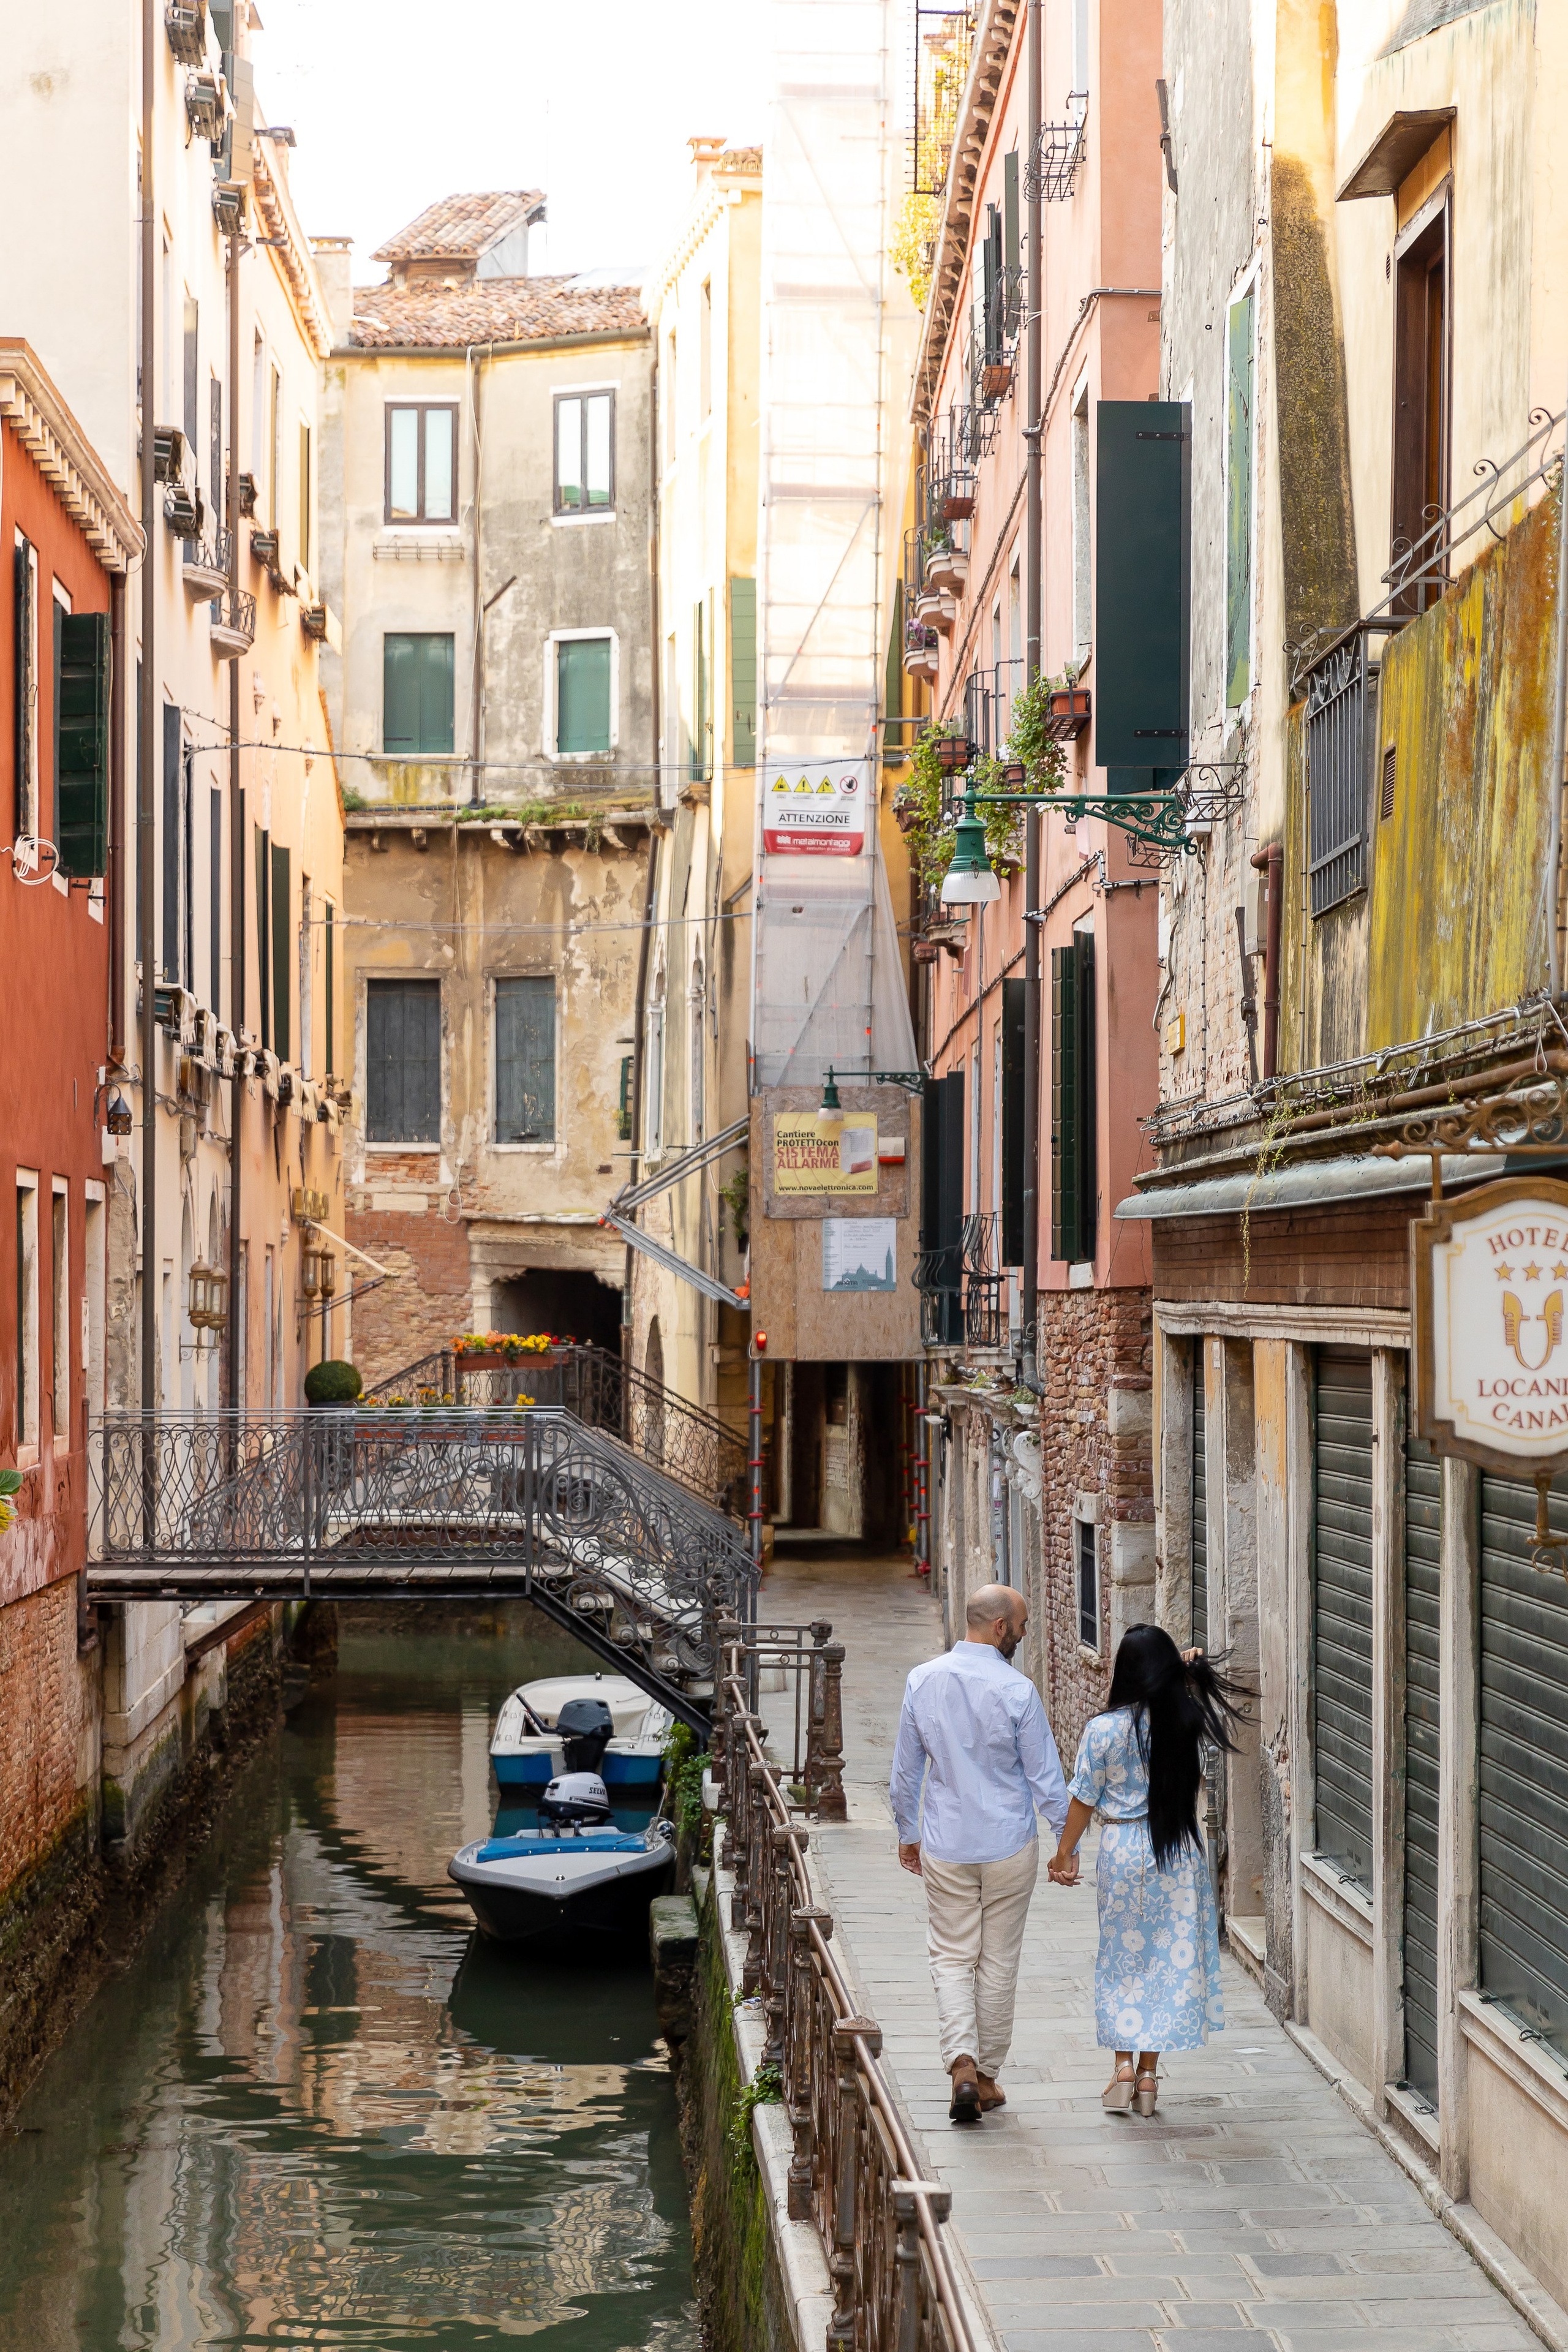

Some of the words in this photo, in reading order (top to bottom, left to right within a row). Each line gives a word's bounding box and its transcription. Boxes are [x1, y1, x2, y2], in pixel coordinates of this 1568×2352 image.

[778, 813, 850, 824] ATTENZIONE
[777, 1129, 816, 1138] Cantiere
[777, 1146, 840, 1158] SISTEMA
[777, 1158, 840, 1169] ALLARME
[589, 1787, 606, 1795] SELVA
